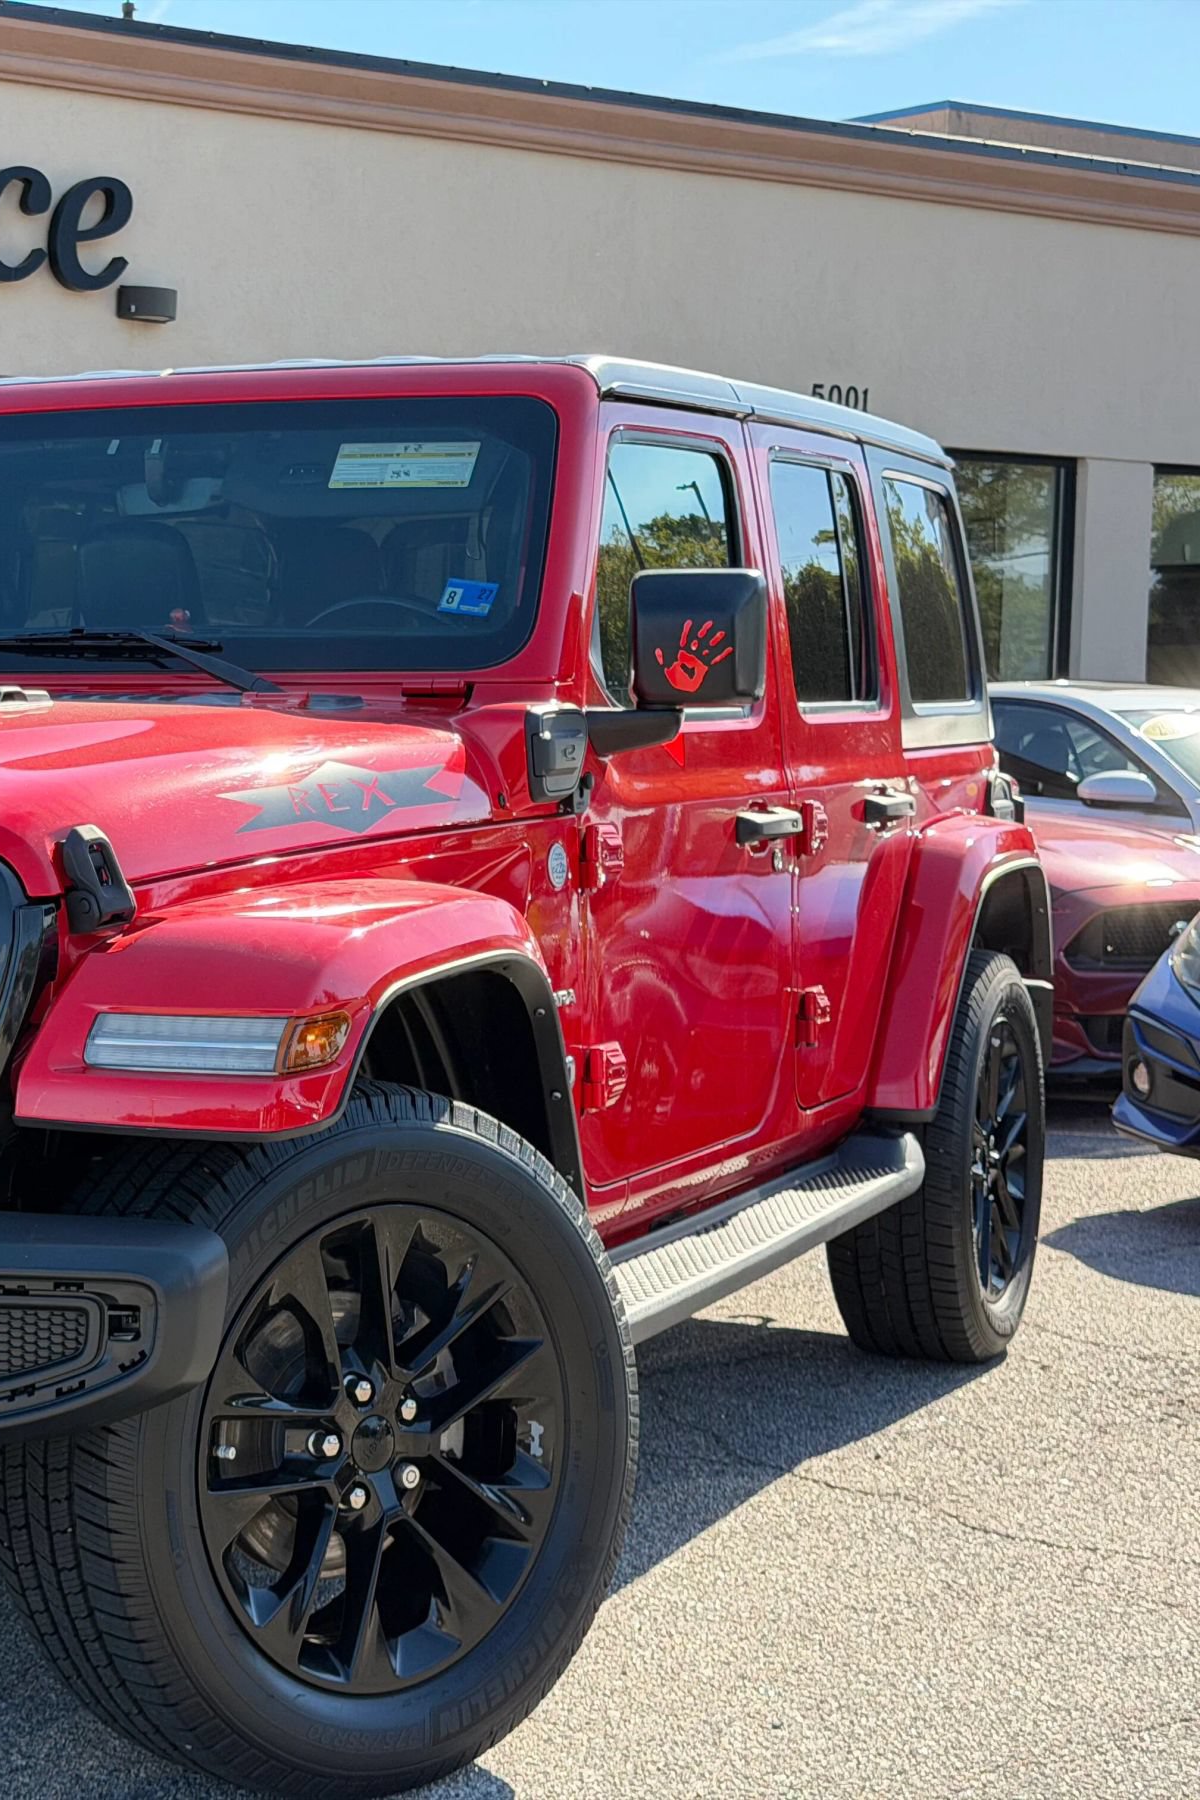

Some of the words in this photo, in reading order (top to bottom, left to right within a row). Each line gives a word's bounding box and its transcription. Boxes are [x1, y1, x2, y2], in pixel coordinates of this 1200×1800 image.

[811, 383, 869, 412] 5001
[446, 590, 457, 605] 8
[477, 588, 495, 602] 27
[287, 774, 396, 817] REX
[230, 1156, 369, 1266] MICHELIN
